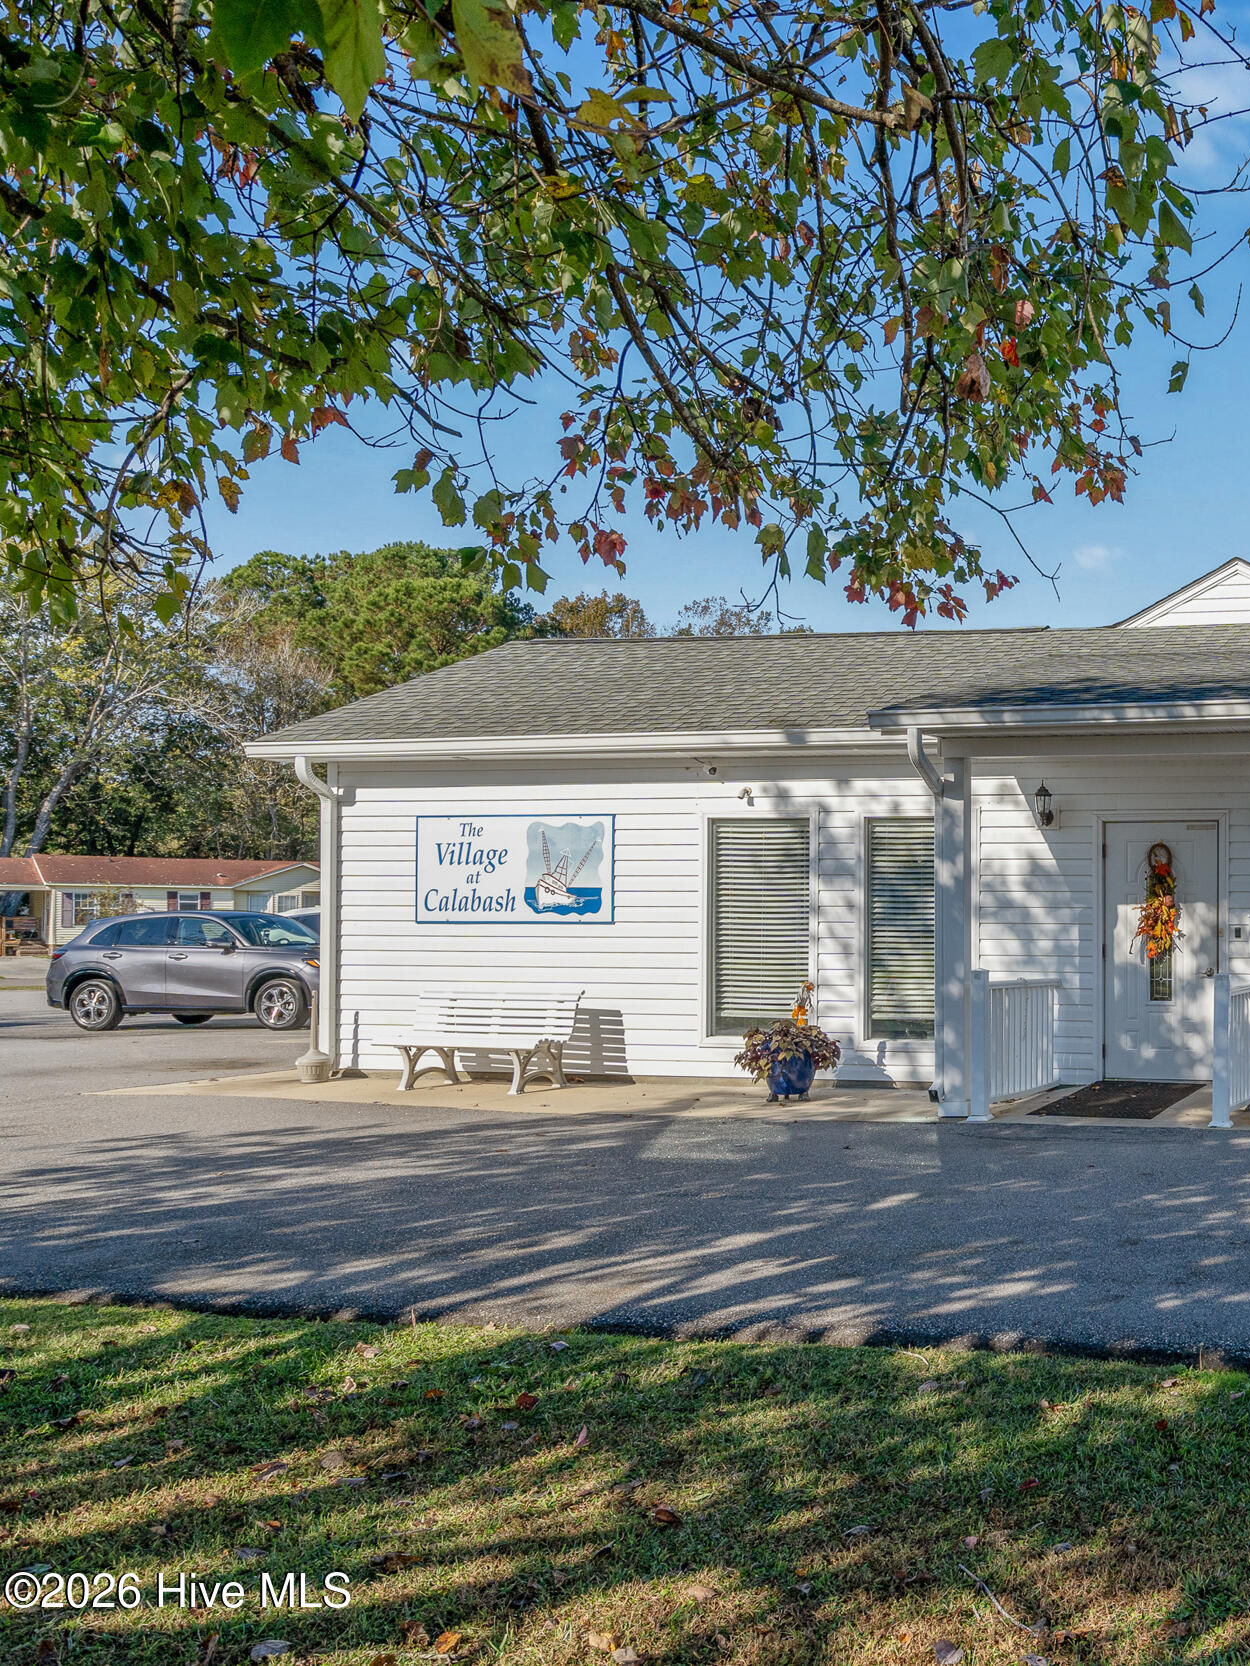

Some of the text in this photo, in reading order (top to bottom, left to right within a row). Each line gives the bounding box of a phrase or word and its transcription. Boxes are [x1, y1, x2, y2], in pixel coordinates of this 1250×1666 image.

[459, 822, 484, 838] The
[435, 842, 508, 873] Village
[466, 870, 481, 884] at
[424, 888, 516, 912] Calabash
